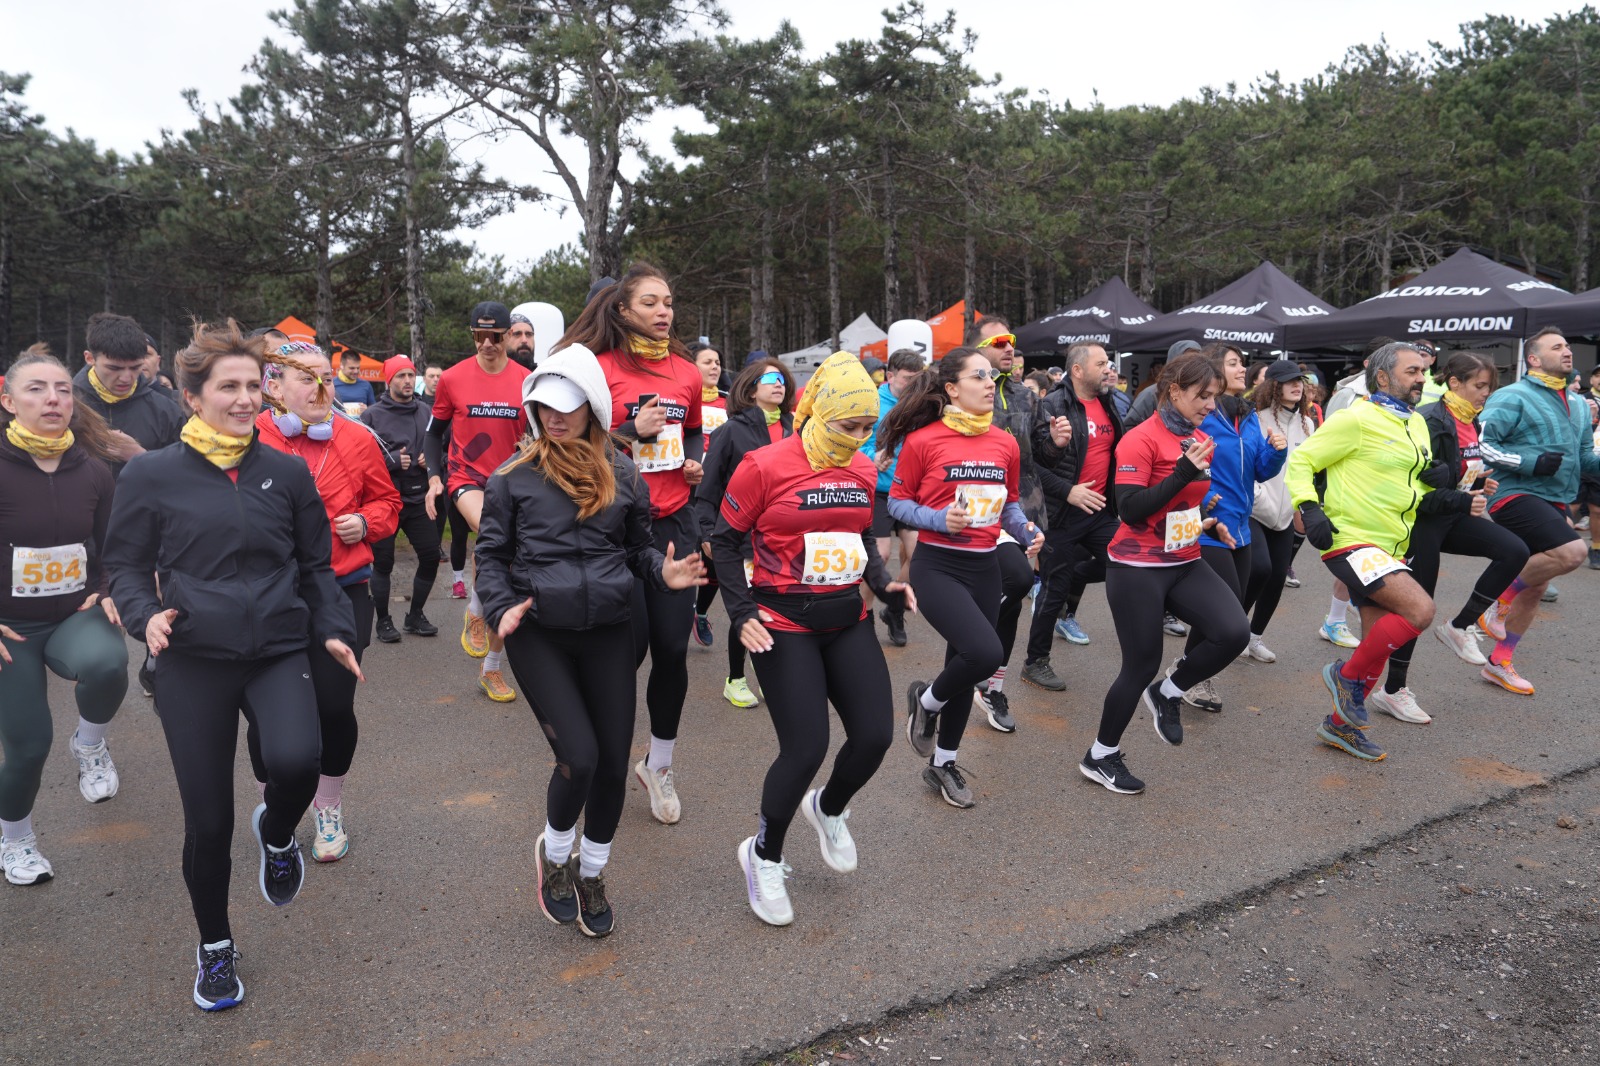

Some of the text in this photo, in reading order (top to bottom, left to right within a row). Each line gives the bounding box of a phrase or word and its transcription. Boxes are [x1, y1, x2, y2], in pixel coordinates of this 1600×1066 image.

[1177, 302, 1268, 315] SALOMON
[1407, 316, 1514, 333] SALOMON
[1203, 328, 1274, 344] SALOMON
[471, 407, 517, 417] RUNNERS
[640, 438, 681, 461] 478
[950, 468, 1004, 480] RUNNERS
[839, 481, 857, 489] TEAM
[807, 491, 868, 506] RUNNERS
[1171, 518, 1202, 542] 396
[812, 548, 860, 573] 531
[1361, 553, 1397, 573] 49
[22, 559, 81, 585] 584
